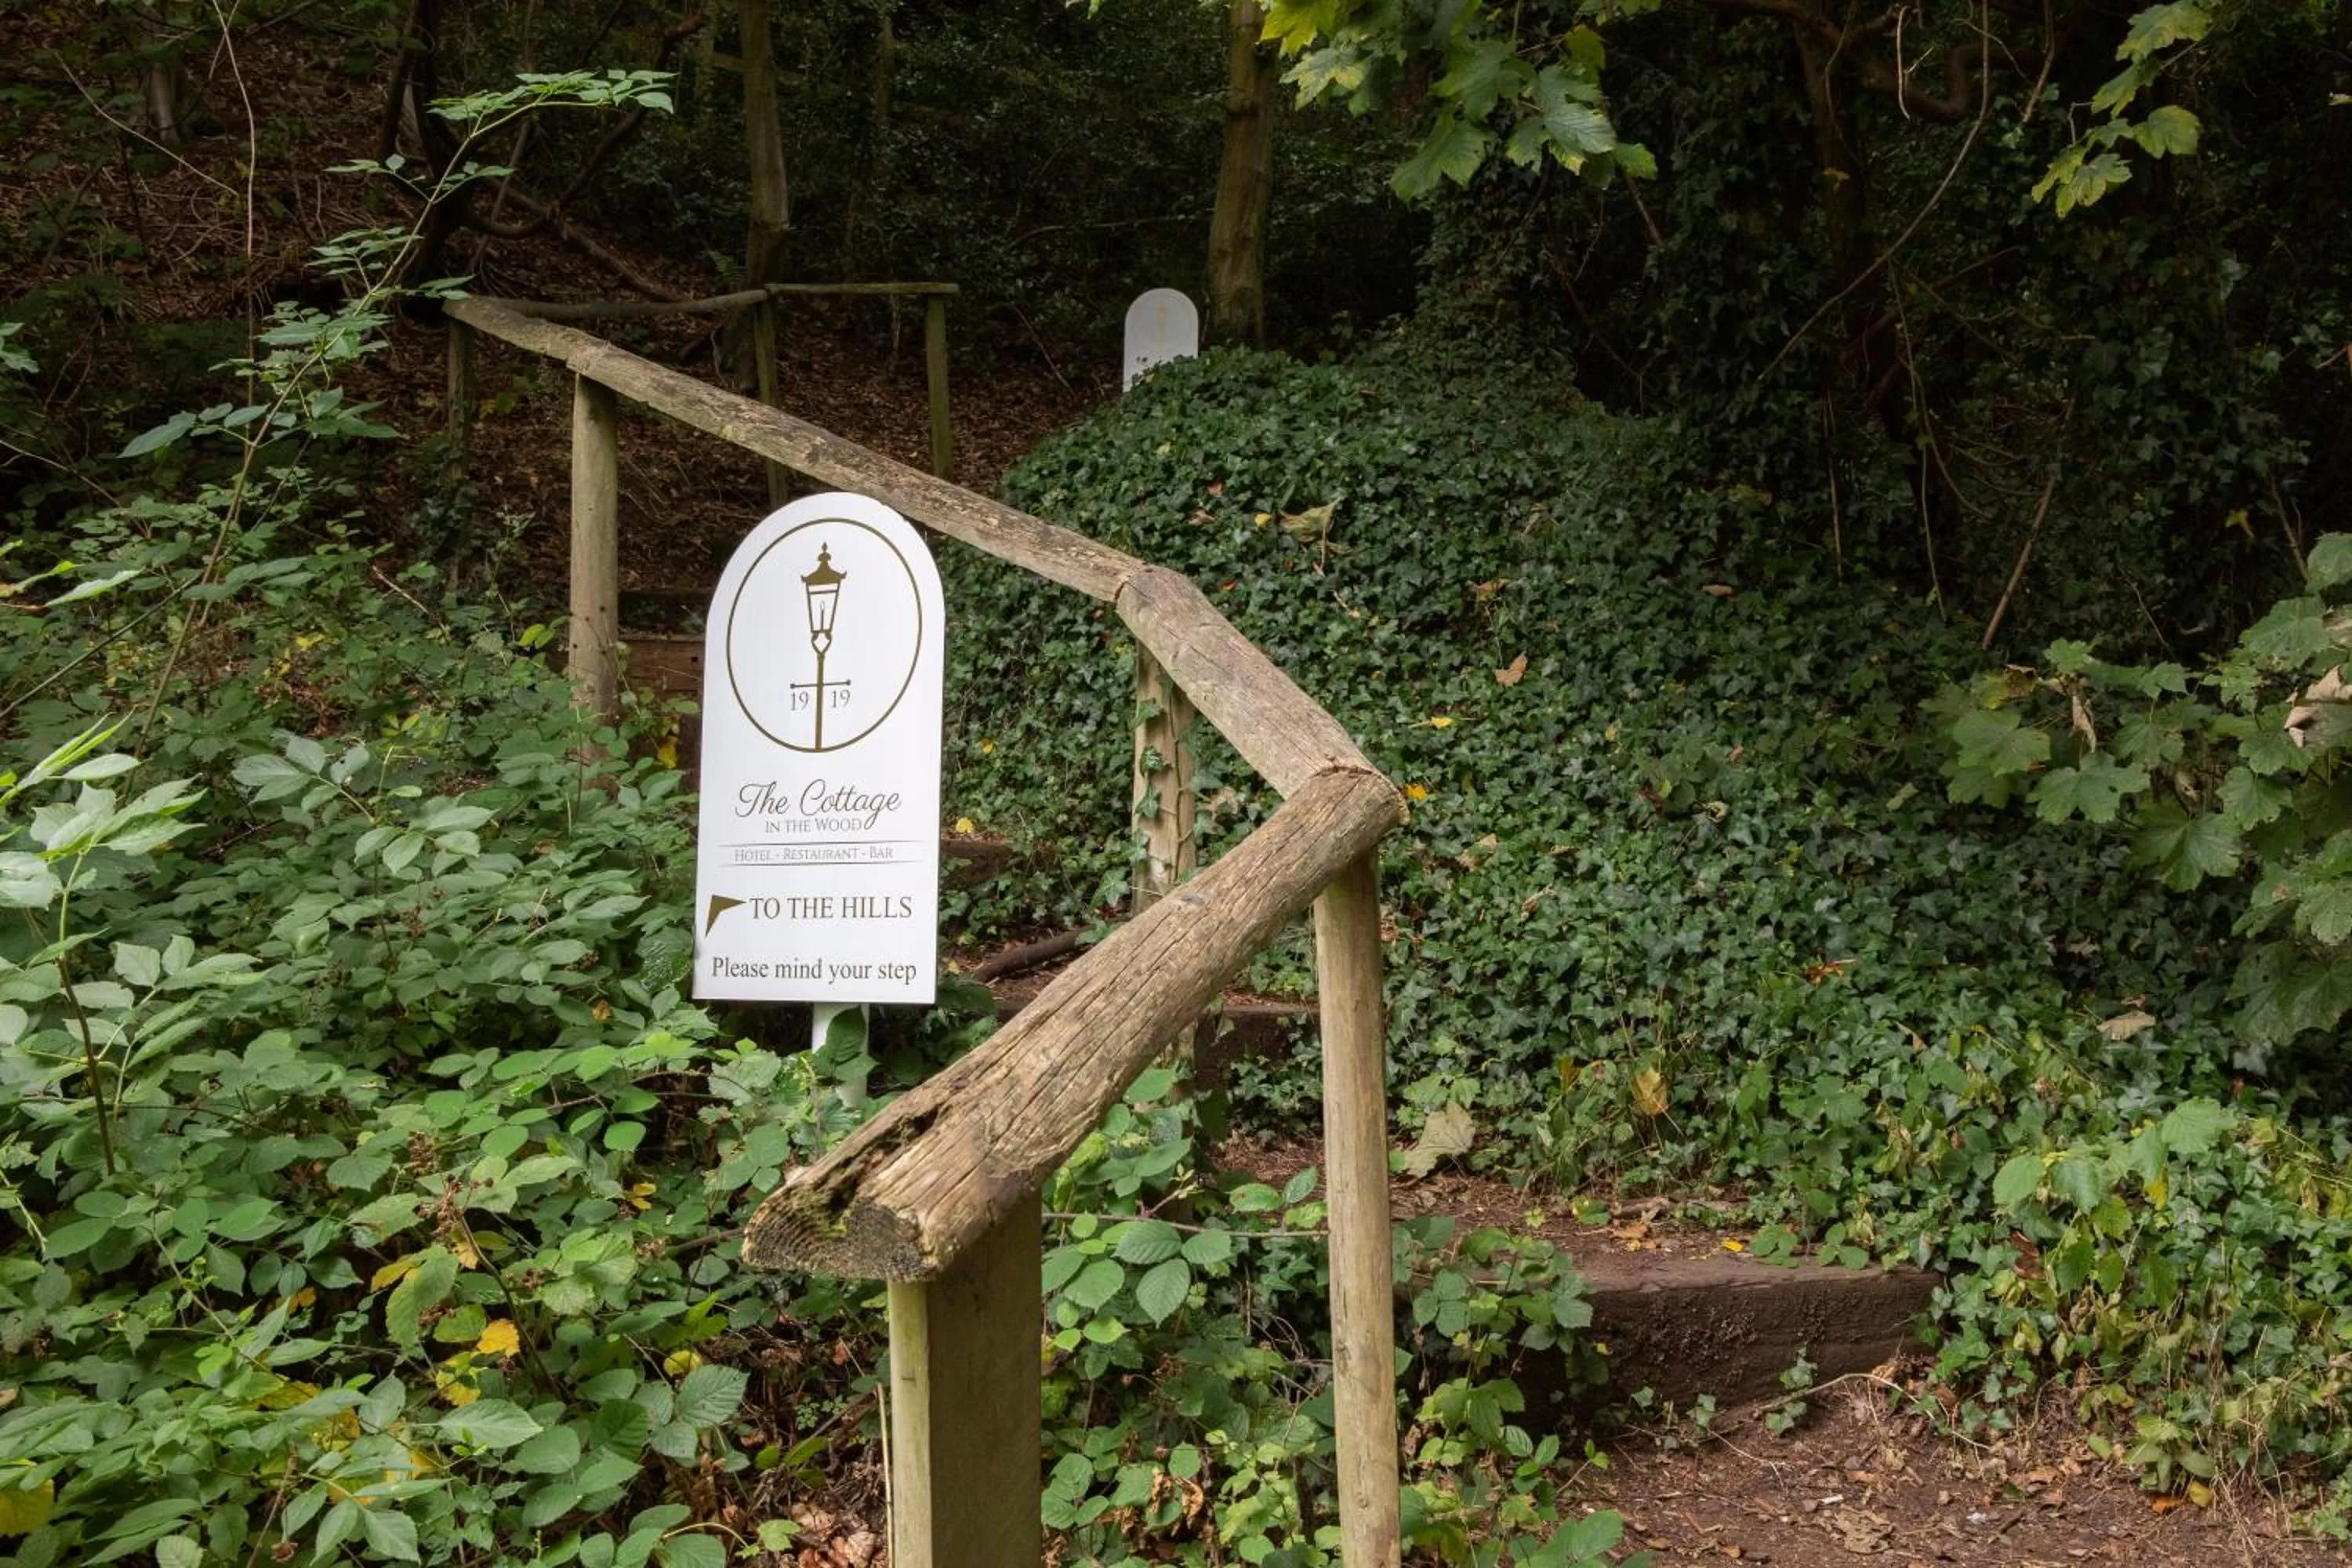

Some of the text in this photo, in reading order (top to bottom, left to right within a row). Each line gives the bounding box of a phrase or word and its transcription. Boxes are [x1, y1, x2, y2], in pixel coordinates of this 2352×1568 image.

[790, 689, 851, 711] 19 19
[735, 779, 901, 830] The Cottage
[765, 818, 862, 833] IN THE WOOD
[735, 847, 893, 862] HOTEL RESTAURANT BAR
[750, 896, 912, 919] TO THE HILLS
[712, 956, 916, 985] Please mind your step
